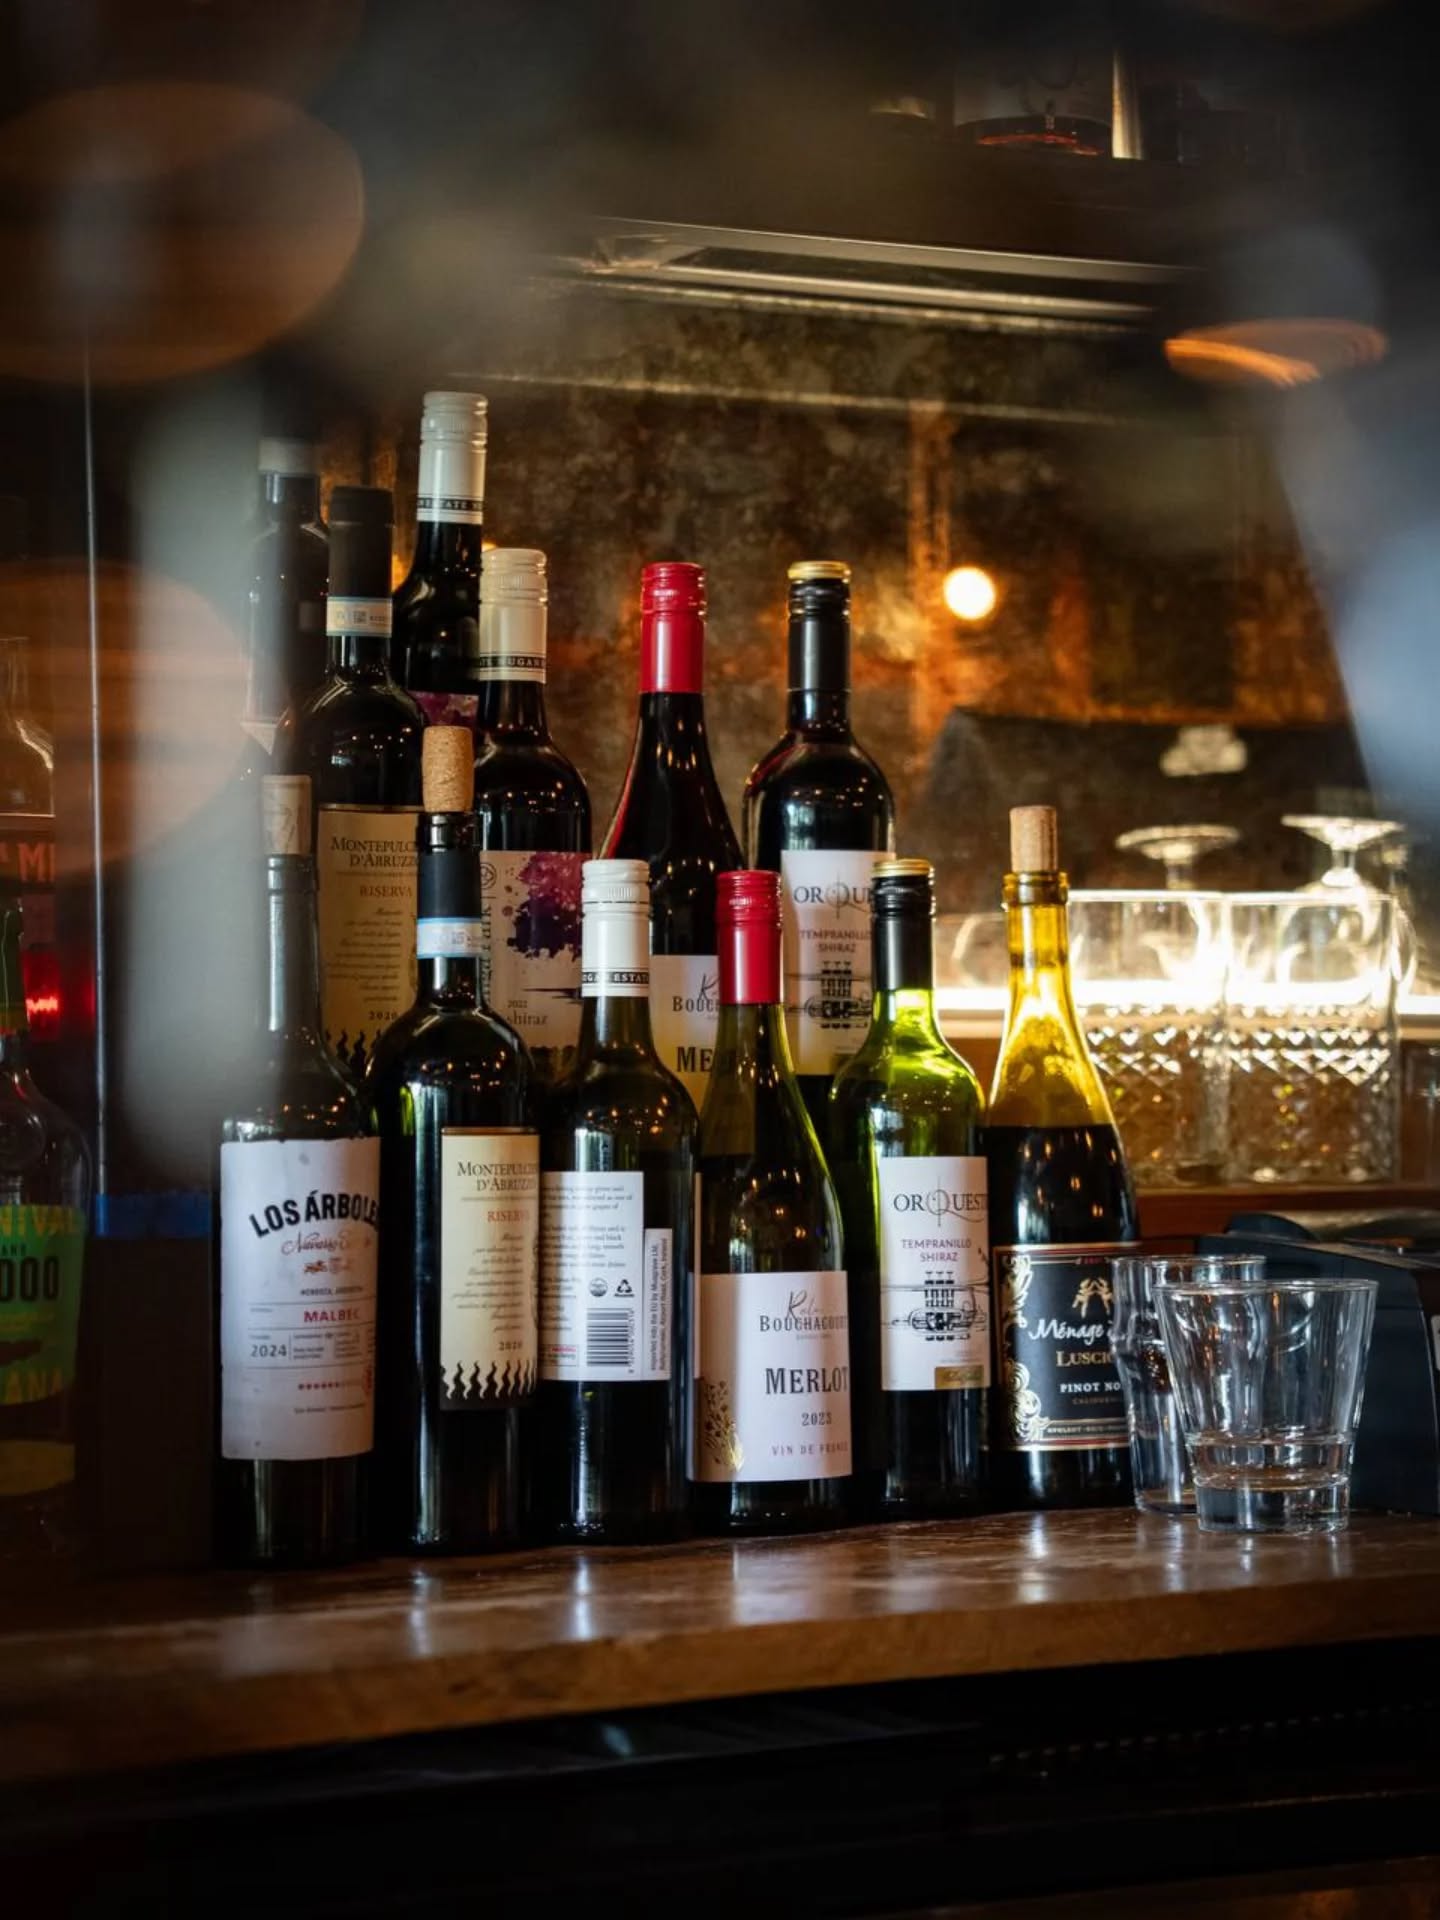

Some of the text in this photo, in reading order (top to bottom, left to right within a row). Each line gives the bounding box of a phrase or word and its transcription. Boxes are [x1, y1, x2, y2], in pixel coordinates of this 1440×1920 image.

[249, 1199, 300, 1238] LOS
[902, 1239, 972, 1251] TEMPRANILLO
[920, 1252, 959, 1264] SHIRAZ
[303, 1308, 361, 1323] MALBEC
[1028, 1319, 1104, 1346] Ménage
[250, 1344, 288, 1358] 2024
[765, 1366, 849, 1395] MERLOT
[1060, 1383, 1100, 1393] PINOT
[772, 1444, 794, 1456] VIN
[800, 1442, 815, 1455] DE
